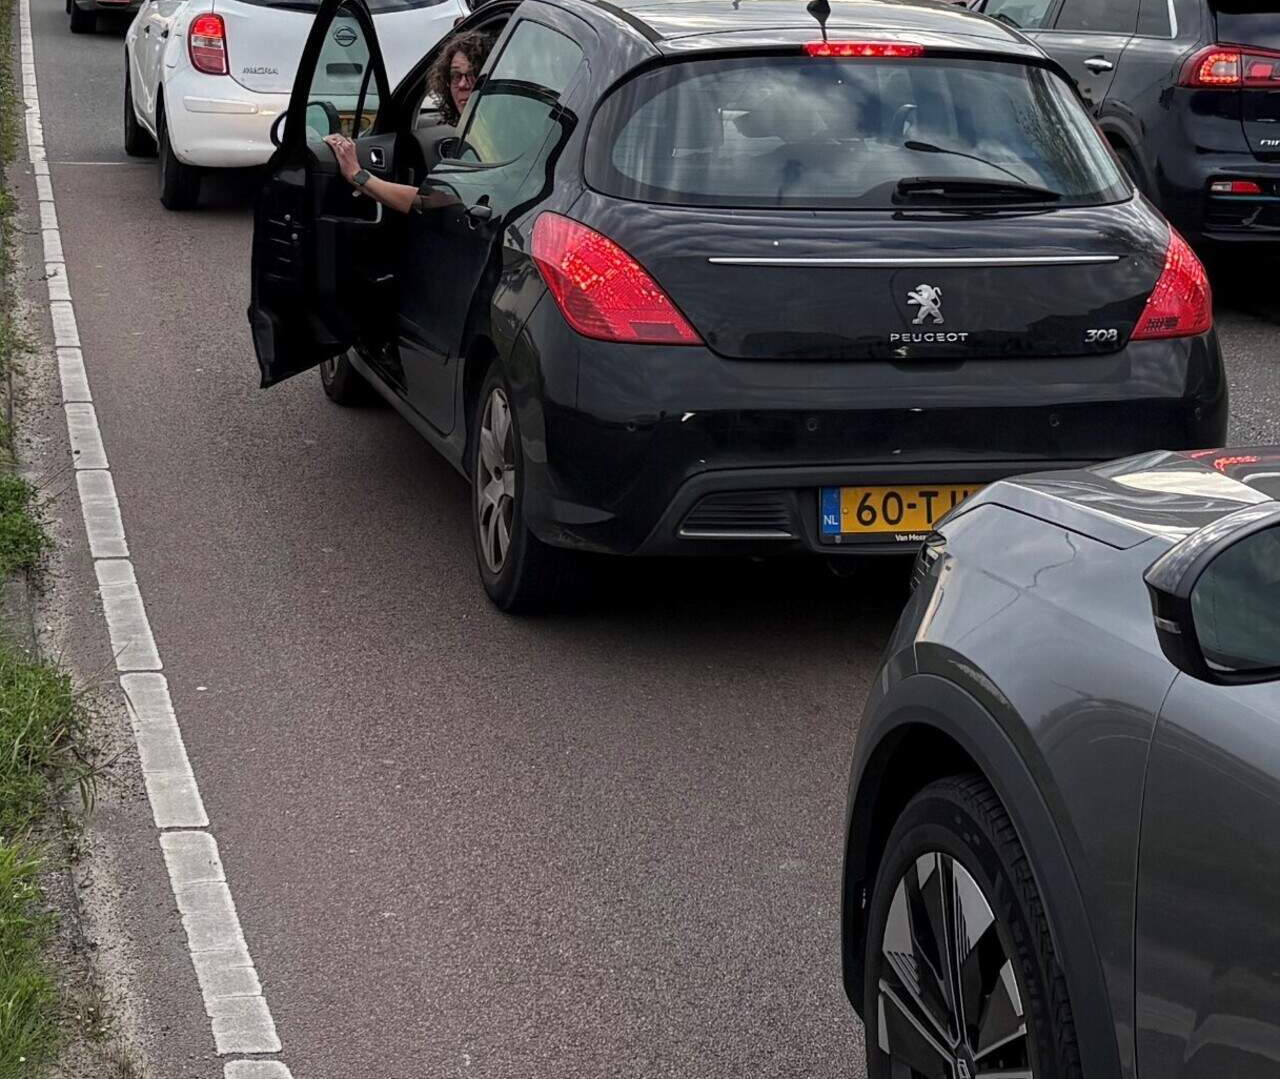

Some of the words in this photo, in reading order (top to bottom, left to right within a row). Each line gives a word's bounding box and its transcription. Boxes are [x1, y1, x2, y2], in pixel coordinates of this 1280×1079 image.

[890, 332, 969, 342] PEUGEOT
[1085, 329, 1118, 343] 308
[823, 514, 839, 526] NL
